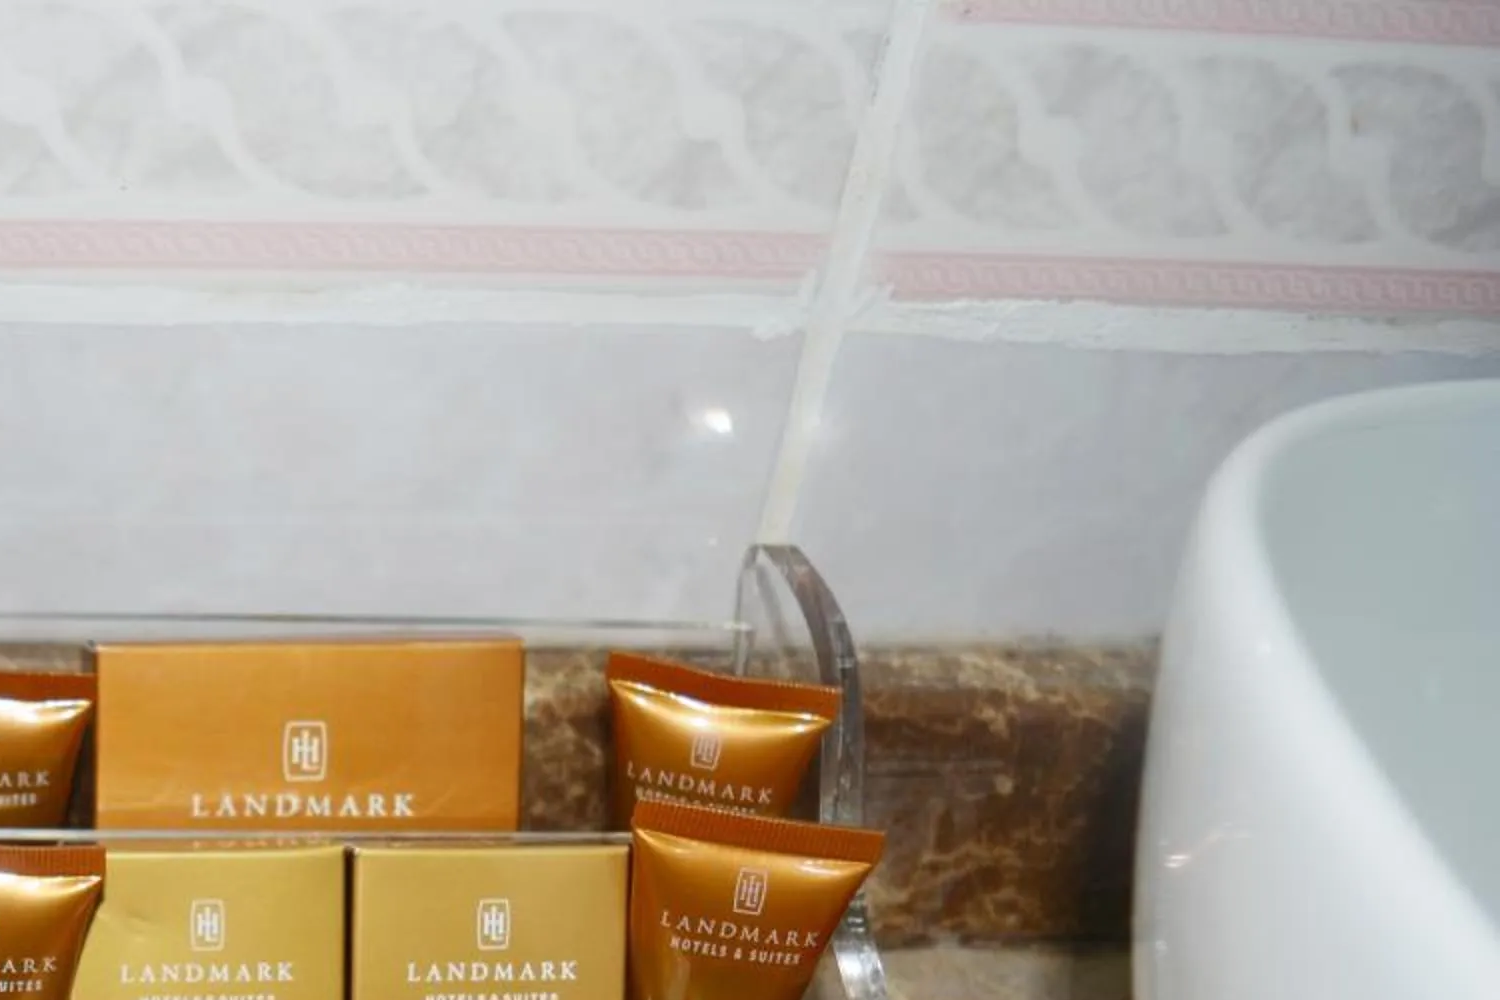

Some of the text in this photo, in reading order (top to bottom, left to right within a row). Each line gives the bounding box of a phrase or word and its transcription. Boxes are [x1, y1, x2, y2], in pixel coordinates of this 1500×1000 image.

[627, 761, 773, 805] LANDMARK
[190, 793, 415, 817] LANDMARK
[660, 910, 821, 948] LANDMARK
[670, 936, 728, 959] HOTELS
[749, 949, 801, 965] SUITES
[120, 961, 294, 983] LANDMARK
[407, 959, 578, 982] LANDMARK
